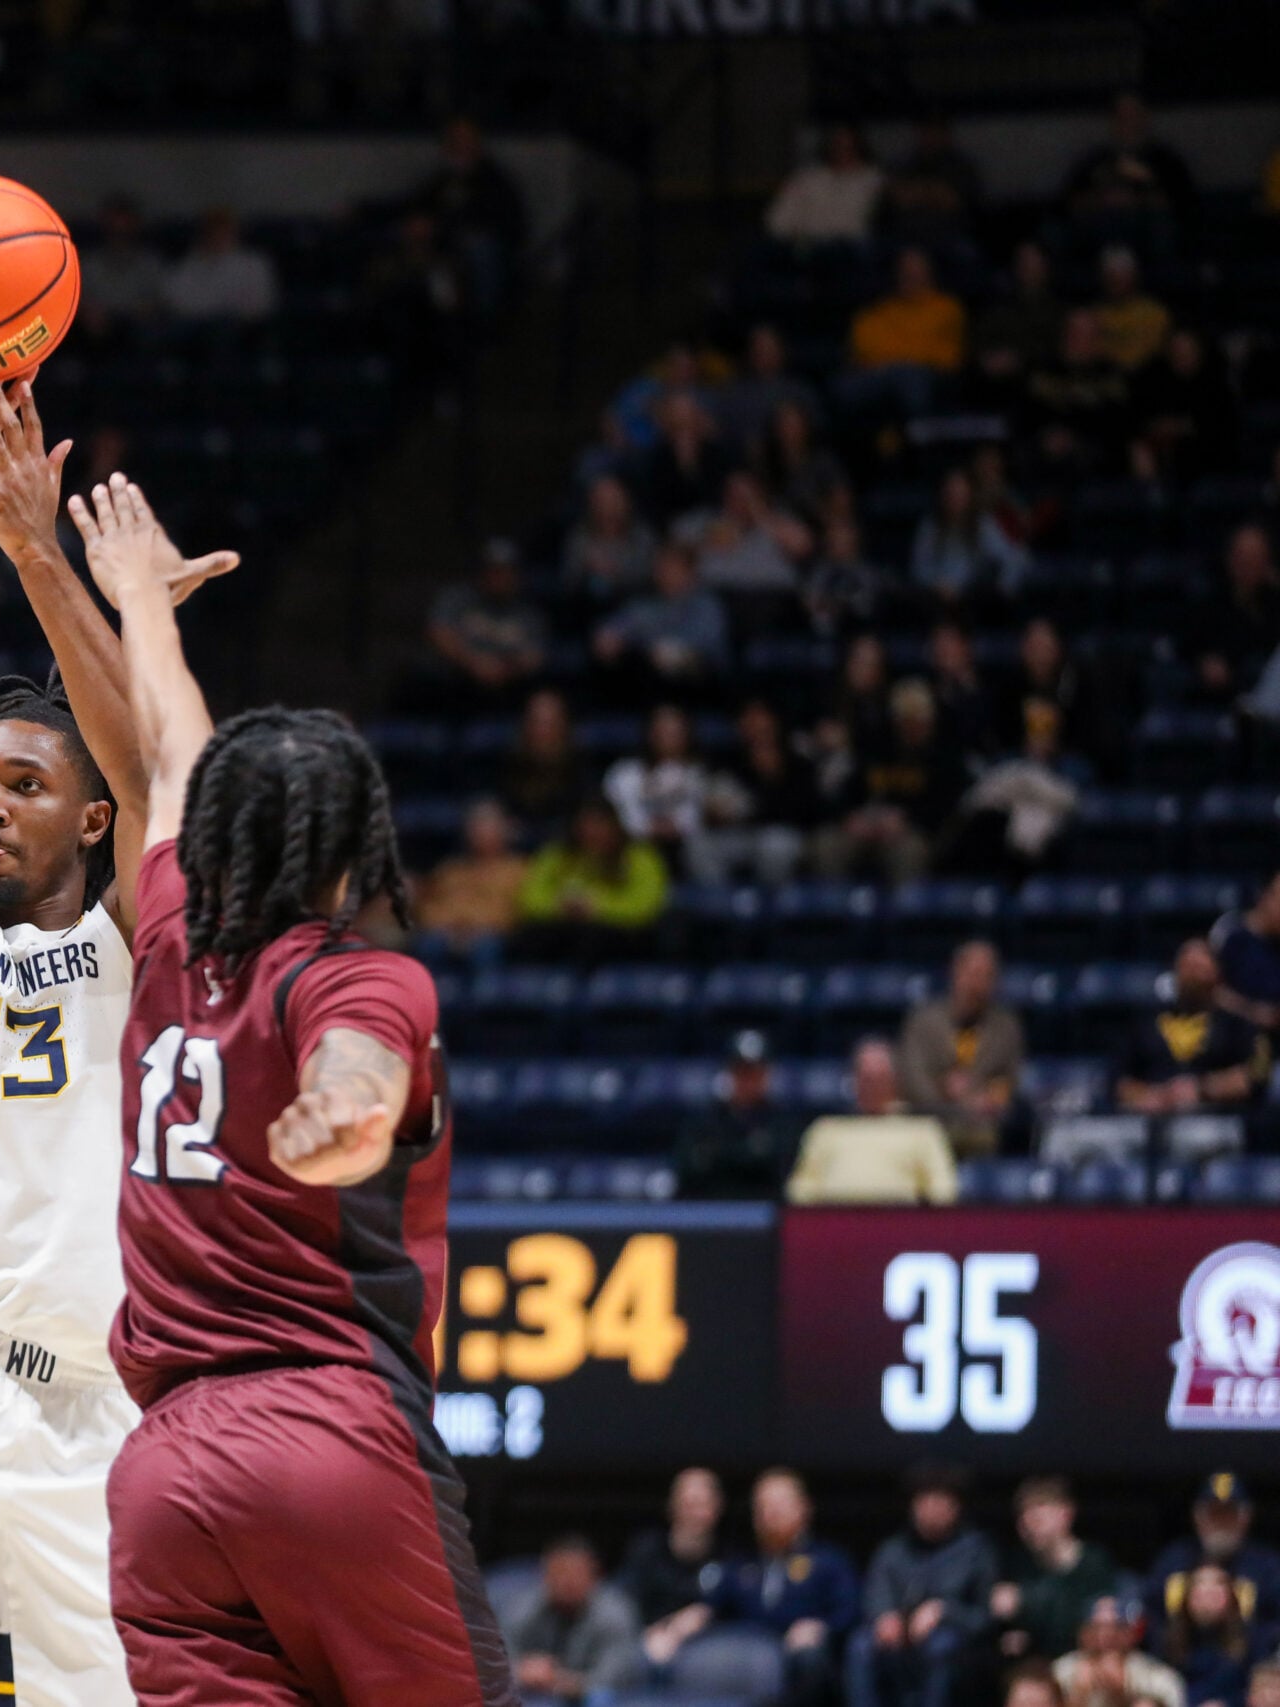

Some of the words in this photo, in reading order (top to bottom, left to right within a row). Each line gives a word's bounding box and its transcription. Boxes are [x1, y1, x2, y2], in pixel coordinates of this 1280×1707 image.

[129, 1024, 228, 1187] 12
[6, 1340, 56, 1383] WVU
[432, 1233, 688, 1383] :34
[881, 1251, 1039, 1434] 35
